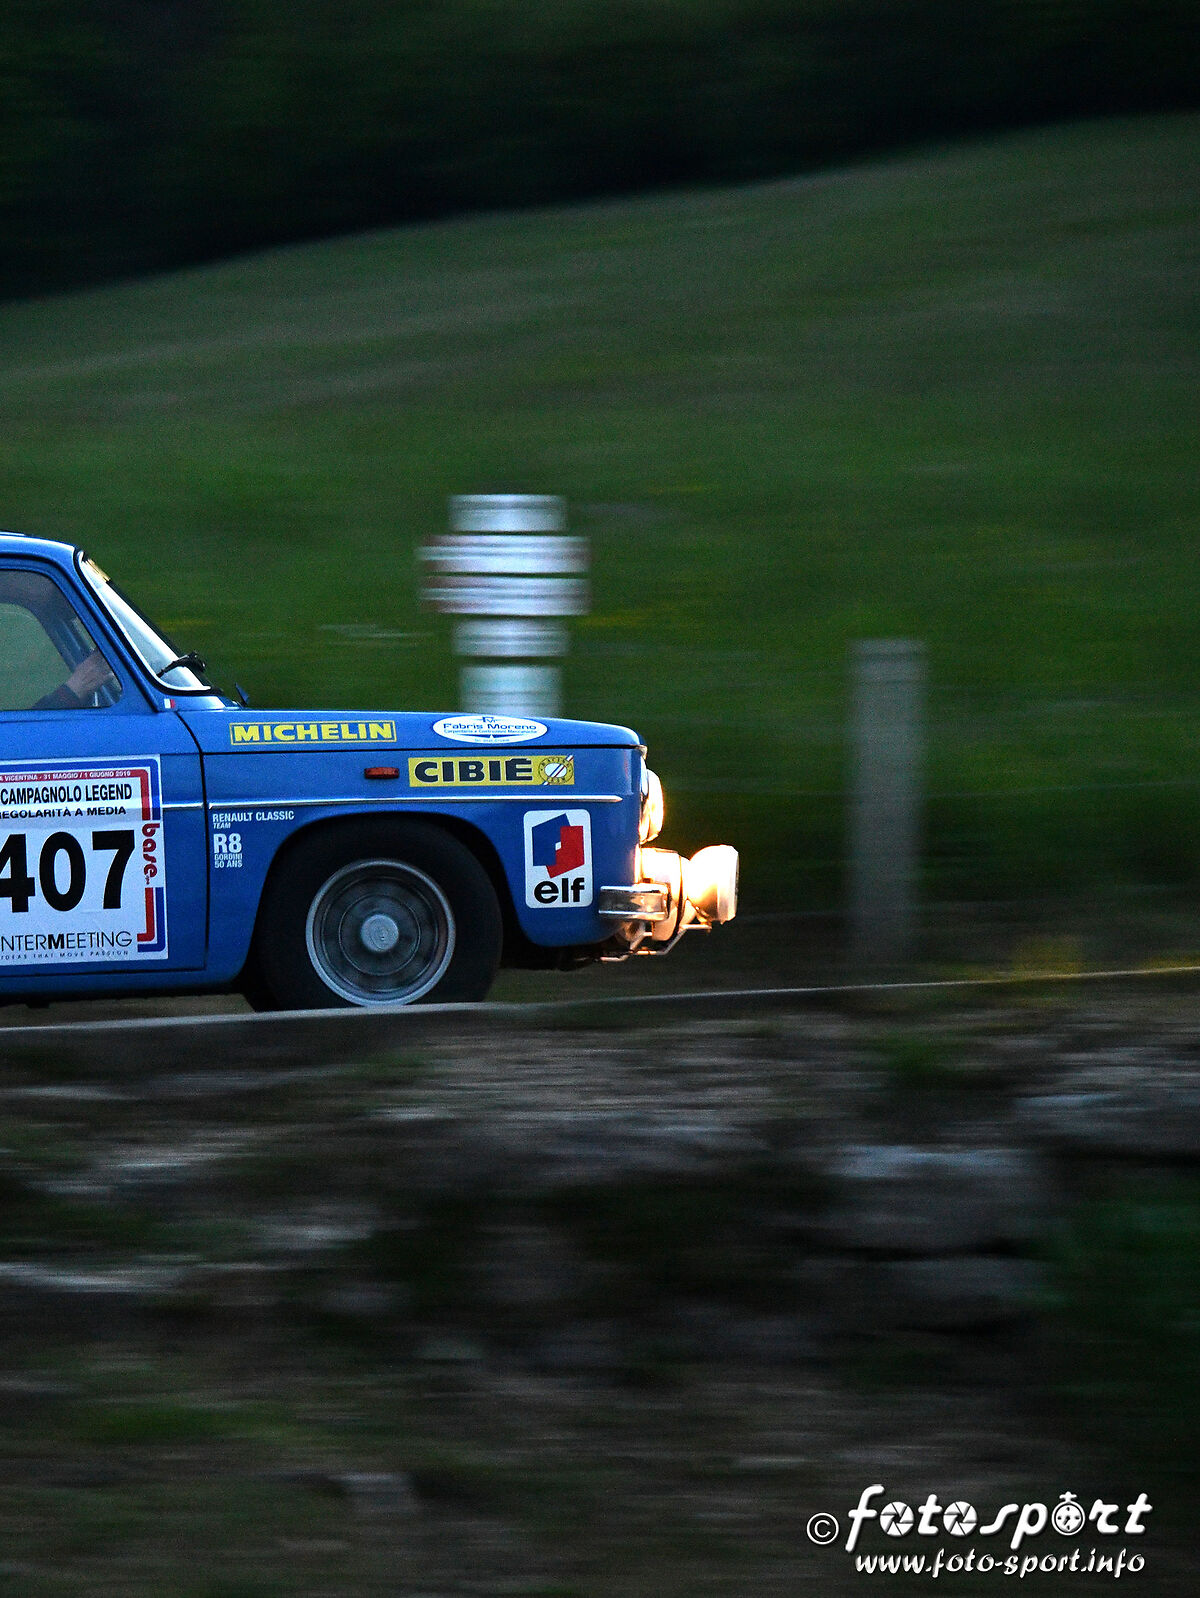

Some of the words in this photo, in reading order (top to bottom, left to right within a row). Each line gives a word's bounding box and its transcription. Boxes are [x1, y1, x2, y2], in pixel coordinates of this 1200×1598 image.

[234, 723, 393, 742] MICHELIN
[4, 774, 38, 782] VICENTINA
[52, 772, 79, 780] MAGGIO
[414, 758, 533, 783] CIBIÉ
[0, 785, 82, 805] CAMPAGNOLO
[85, 783, 132, 801] LEGEND
[75, 807, 83, 817] A
[87, 806, 127, 816] MEDIA
[212, 812, 253, 823] RENAULT
[255, 810, 295, 821] CLASSIC
[213, 832, 243, 854] R8
[214, 853, 243, 861] GORDINI
[226, 860, 243, 868] ANS
[534, 877, 585, 904] elf
[90, 950, 129, 958] PASSION
